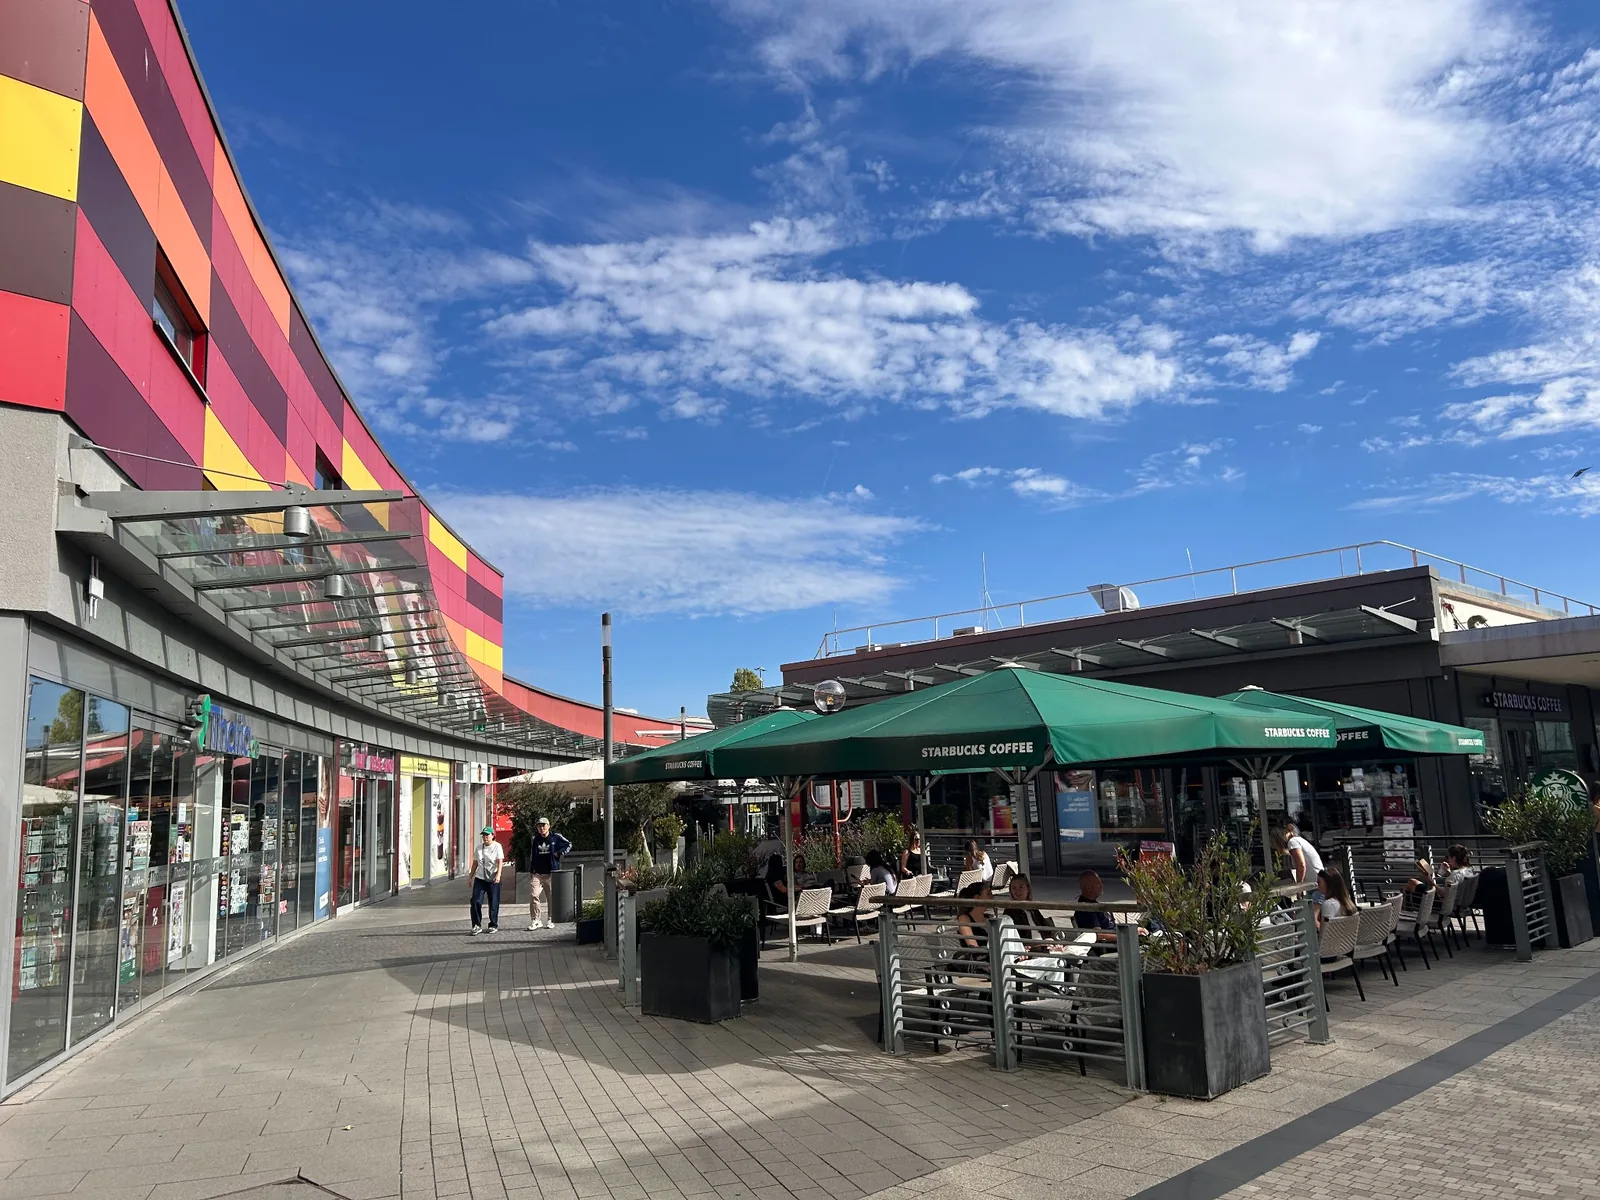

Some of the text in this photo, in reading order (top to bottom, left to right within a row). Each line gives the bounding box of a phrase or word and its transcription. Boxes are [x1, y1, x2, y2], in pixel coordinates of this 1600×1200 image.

[1493, 691, 1563, 712] STARBUCKS COFFEE
[1263, 727, 1331, 739] STARBUCKS COFFEE
[1335, 730, 1369, 742] OFFEE
[921, 741, 1034, 758] STARBUCKS COFFEE
[687, 759, 703, 769] COFFEE
